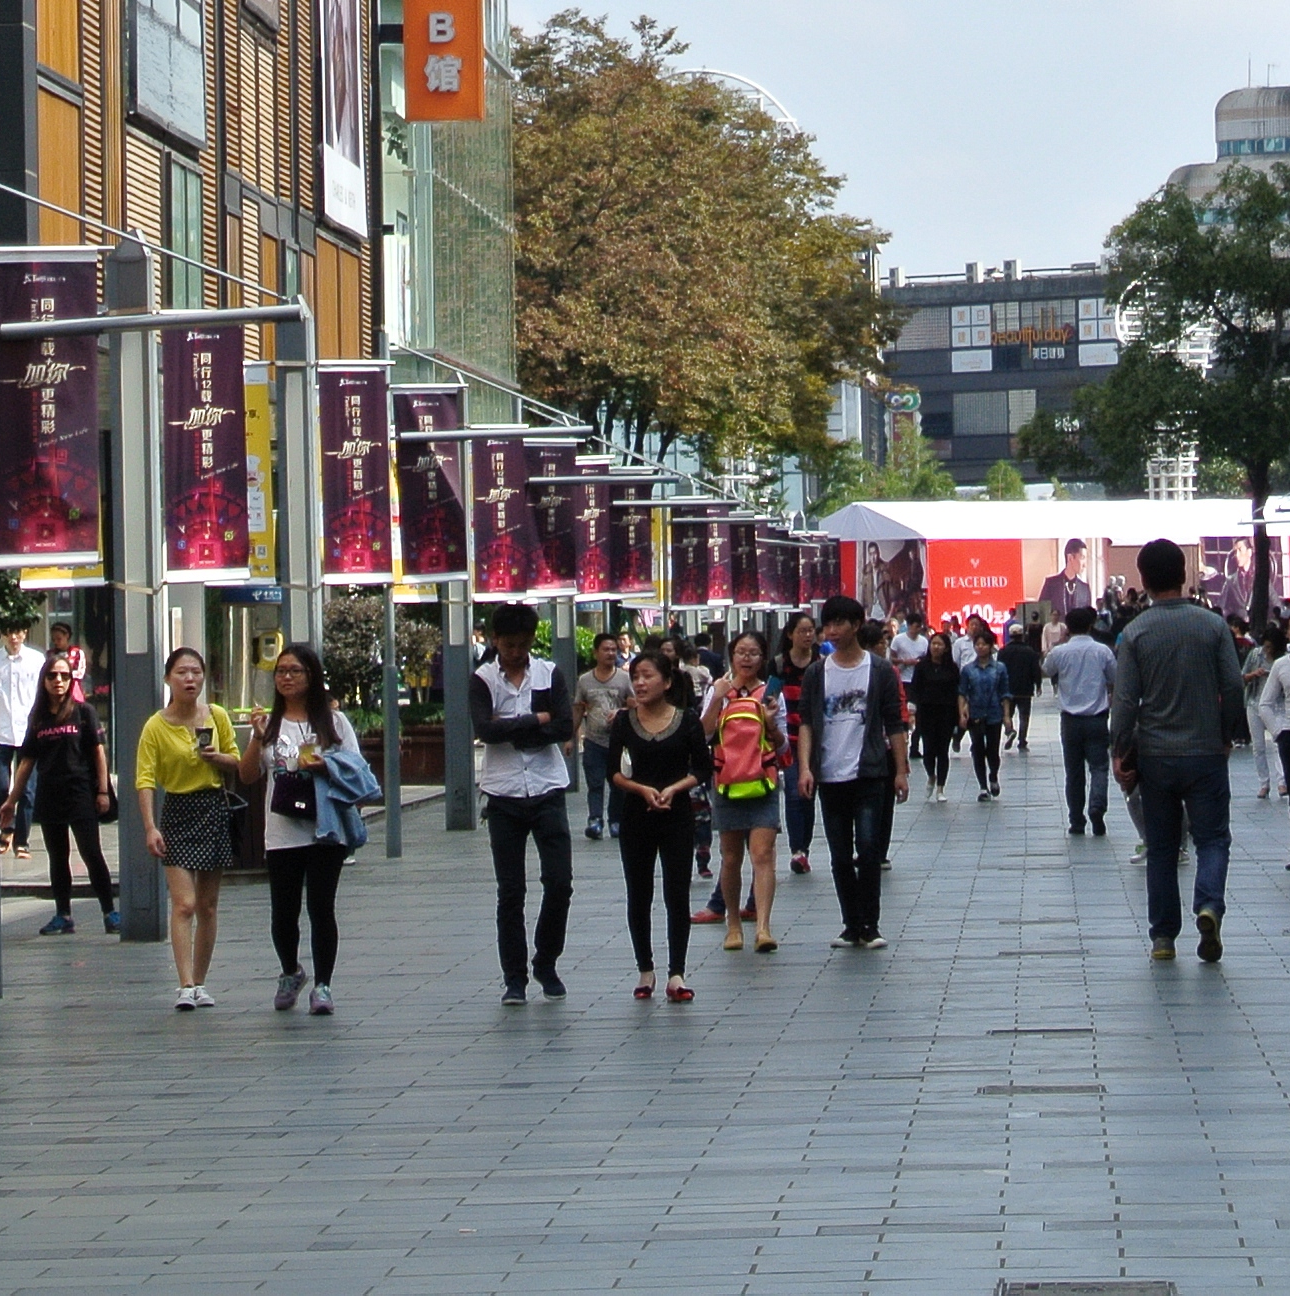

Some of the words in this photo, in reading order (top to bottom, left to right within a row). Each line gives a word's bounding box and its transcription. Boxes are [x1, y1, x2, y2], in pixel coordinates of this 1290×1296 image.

[429, 12, 455, 43] B
[425, 55, 462, 91] 馆
[944, 575, 1008, 589] PEACEBIRD
